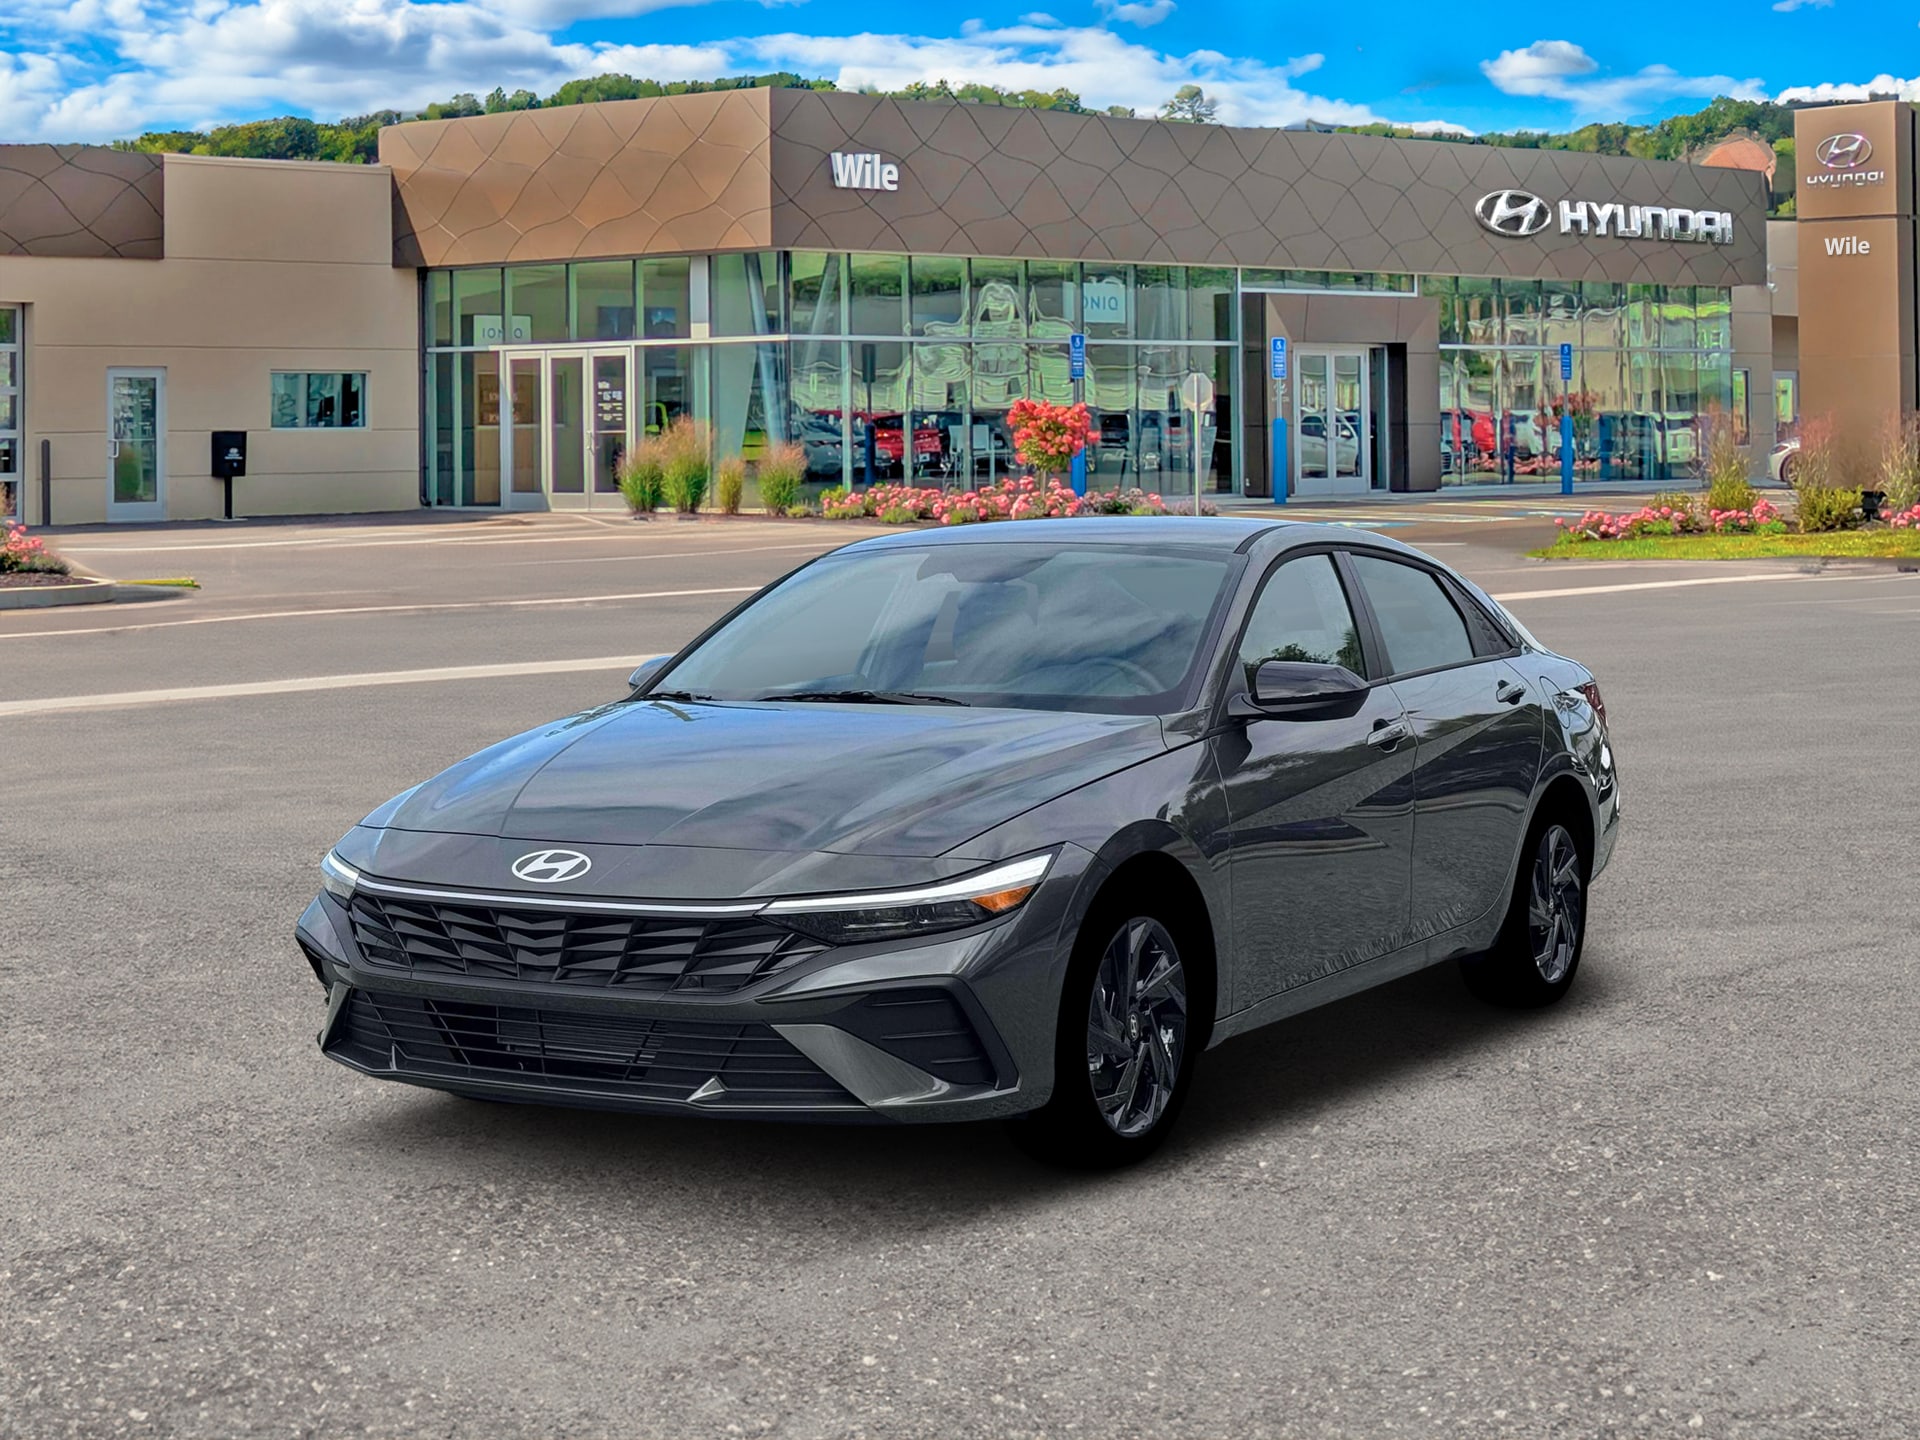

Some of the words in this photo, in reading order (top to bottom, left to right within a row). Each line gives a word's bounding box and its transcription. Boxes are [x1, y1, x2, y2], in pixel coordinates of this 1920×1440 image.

[830, 152, 899, 191] Wile
[1559, 200, 1734, 246] HYUNDAI
[1824, 236, 1870, 256] Wile
